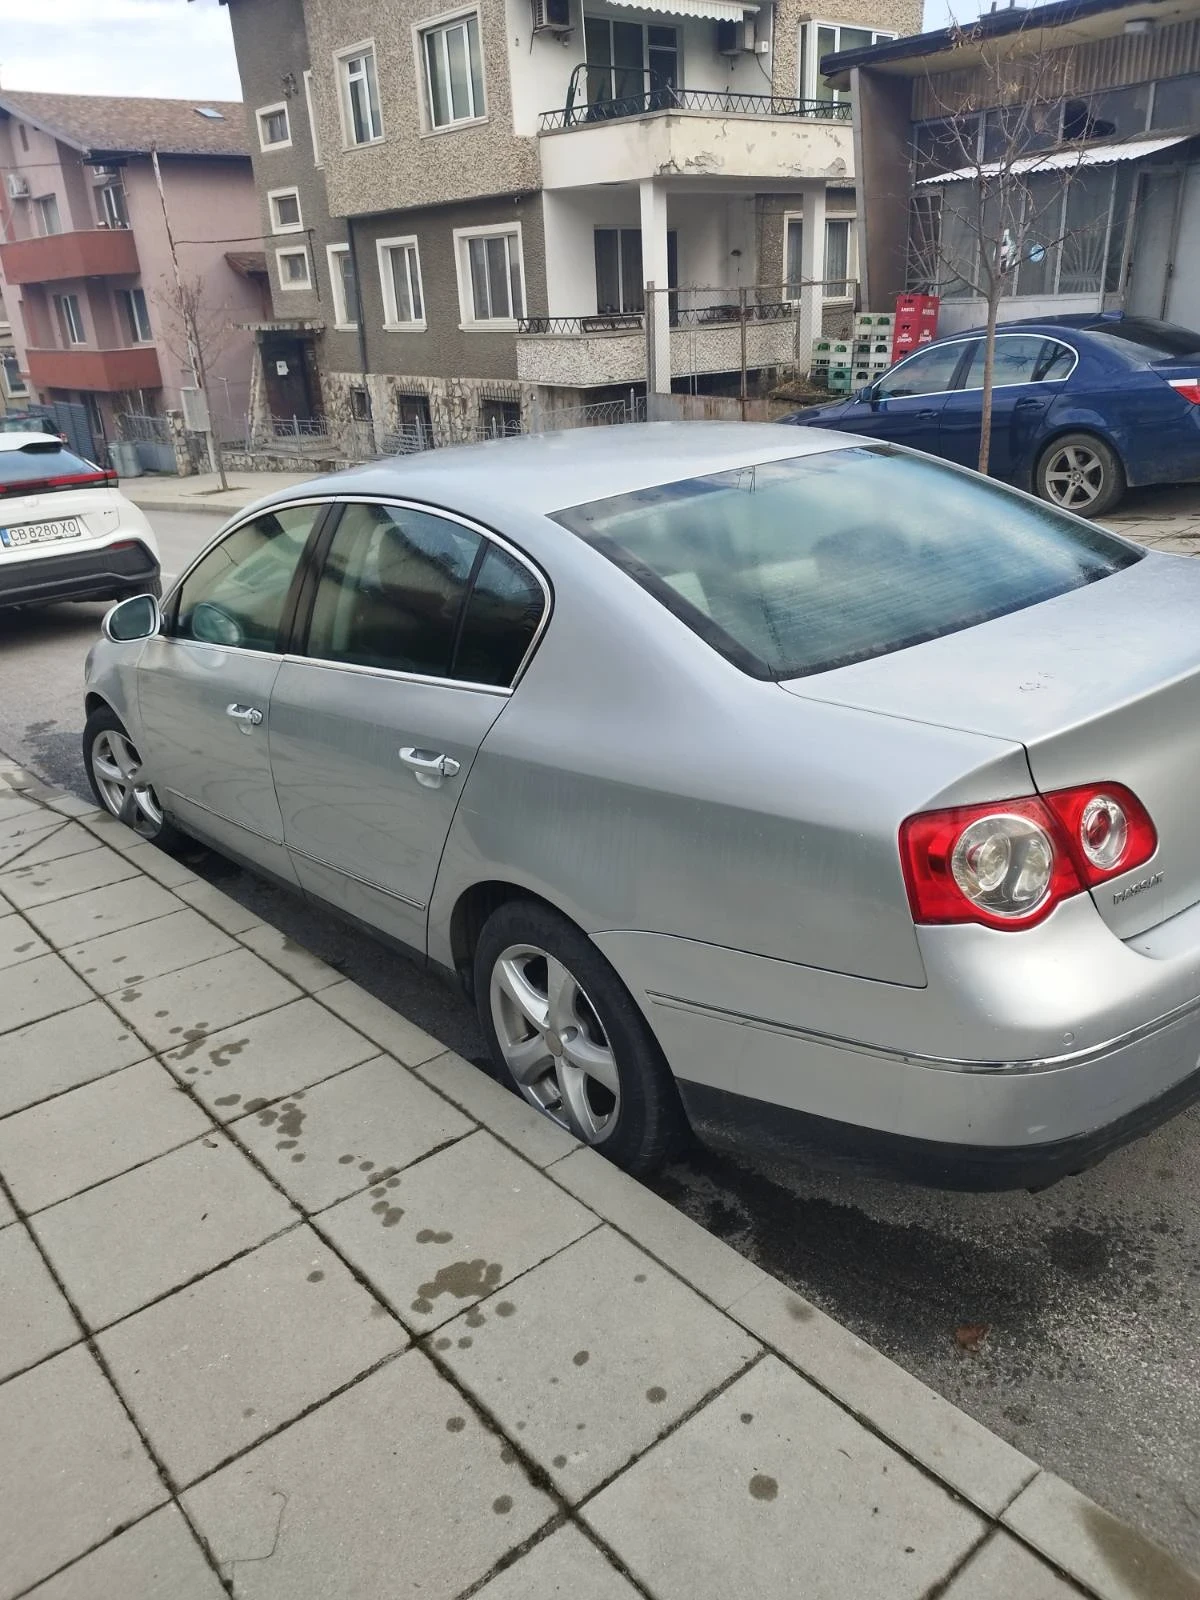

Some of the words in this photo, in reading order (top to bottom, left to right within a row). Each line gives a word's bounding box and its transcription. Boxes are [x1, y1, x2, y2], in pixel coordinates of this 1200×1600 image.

[9, 529, 27, 541] CB
[28, 524, 59, 538] 8280
[60, 521, 76, 533] XO
